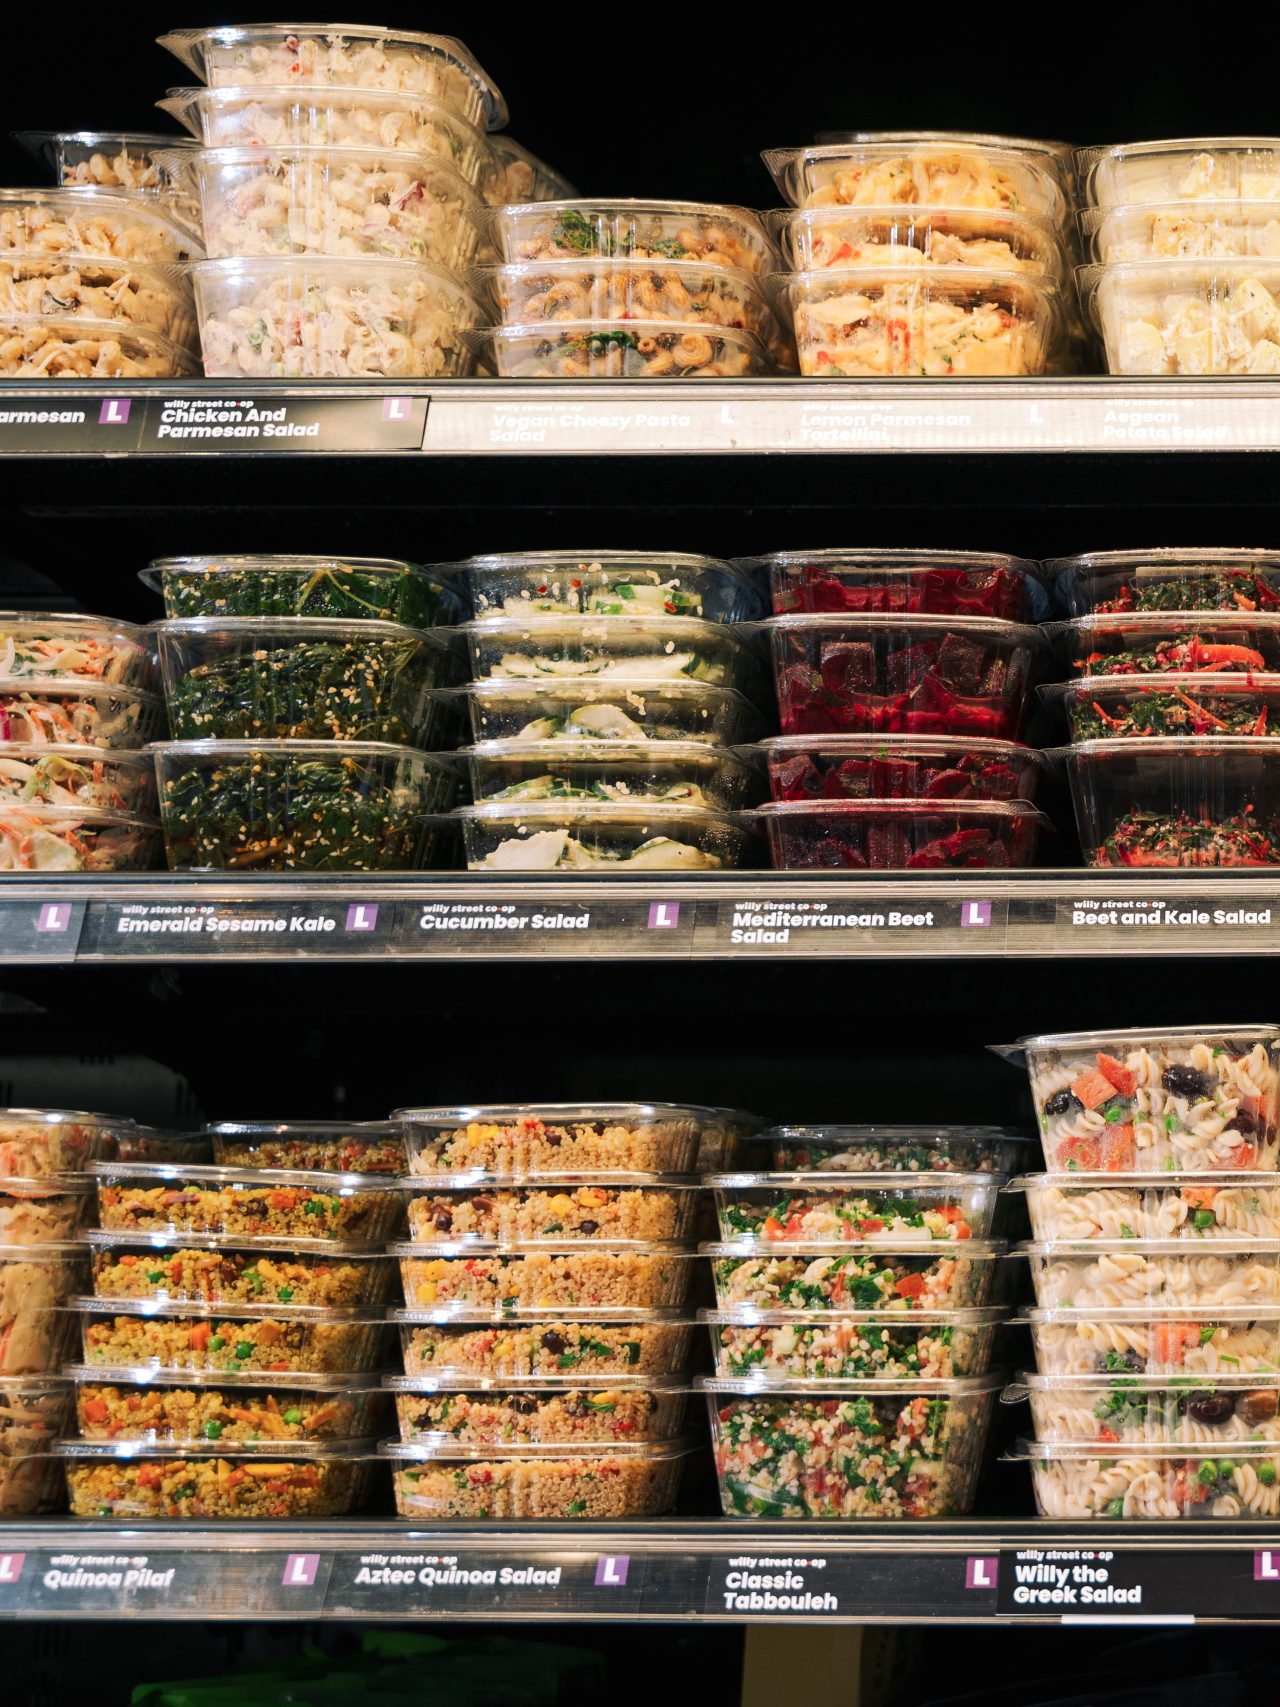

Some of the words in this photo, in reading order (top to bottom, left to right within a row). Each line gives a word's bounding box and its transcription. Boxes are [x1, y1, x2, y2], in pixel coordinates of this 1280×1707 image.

[164, 400, 189, 409] willy
[191, 400, 222, 408] street
[161, 408, 242, 422] Chicken
[245, 408, 286, 422] And
[493, 414, 555, 429] Vegan
[635, 414, 691, 427] Pasta
[801, 414, 865, 426] Lemon
[871, 414, 971, 426] Parmesan
[1104, 410, 1178, 425] Aegean
[158, 424, 260, 438] Parmesan
[264, 423, 320, 438] Salad
[490, 429, 546, 442] Salad
[800, 428, 888, 442] Tortellini
[424, 905, 450, 914] willy
[118, 917, 200, 932] Emerald
[205, 917, 286, 932] Sesame
[290, 917, 336, 932] Kale
[420, 914, 528, 930] Cucumber
[531, 914, 590, 930] Salad
[732, 912, 884, 926] Mediterranean
[888, 912, 934, 926] Beet
[1072, 911, 1118, 925] Beet
[1122, 910, 1160, 924] and
[1164, 910, 1210, 924] Kale
[1214, 910, 1270, 924] Salad
[730, 929, 789, 944] Salad
[1016, 1550, 1044, 1561] willy
[1046, 1550, 1080, 1560] street
[43, 1569, 122, 1588] Quinoa
[124, 1568, 175, 1586] Pilaf
[354, 1567, 416, 1585] Aztec
[418, 1567, 496, 1586] Quinoa
[499, 1567, 561, 1585] Salad
[726, 1572, 804, 1589] Classic
[1015, 1566, 1070, 1587] Willy
[1072, 1565, 1108, 1582] the
[724, 1592, 838, 1610] Tabbouleh
[1014, 1586, 1078, 1604] Greek
[1080, 1586, 1142, 1604] Salad
